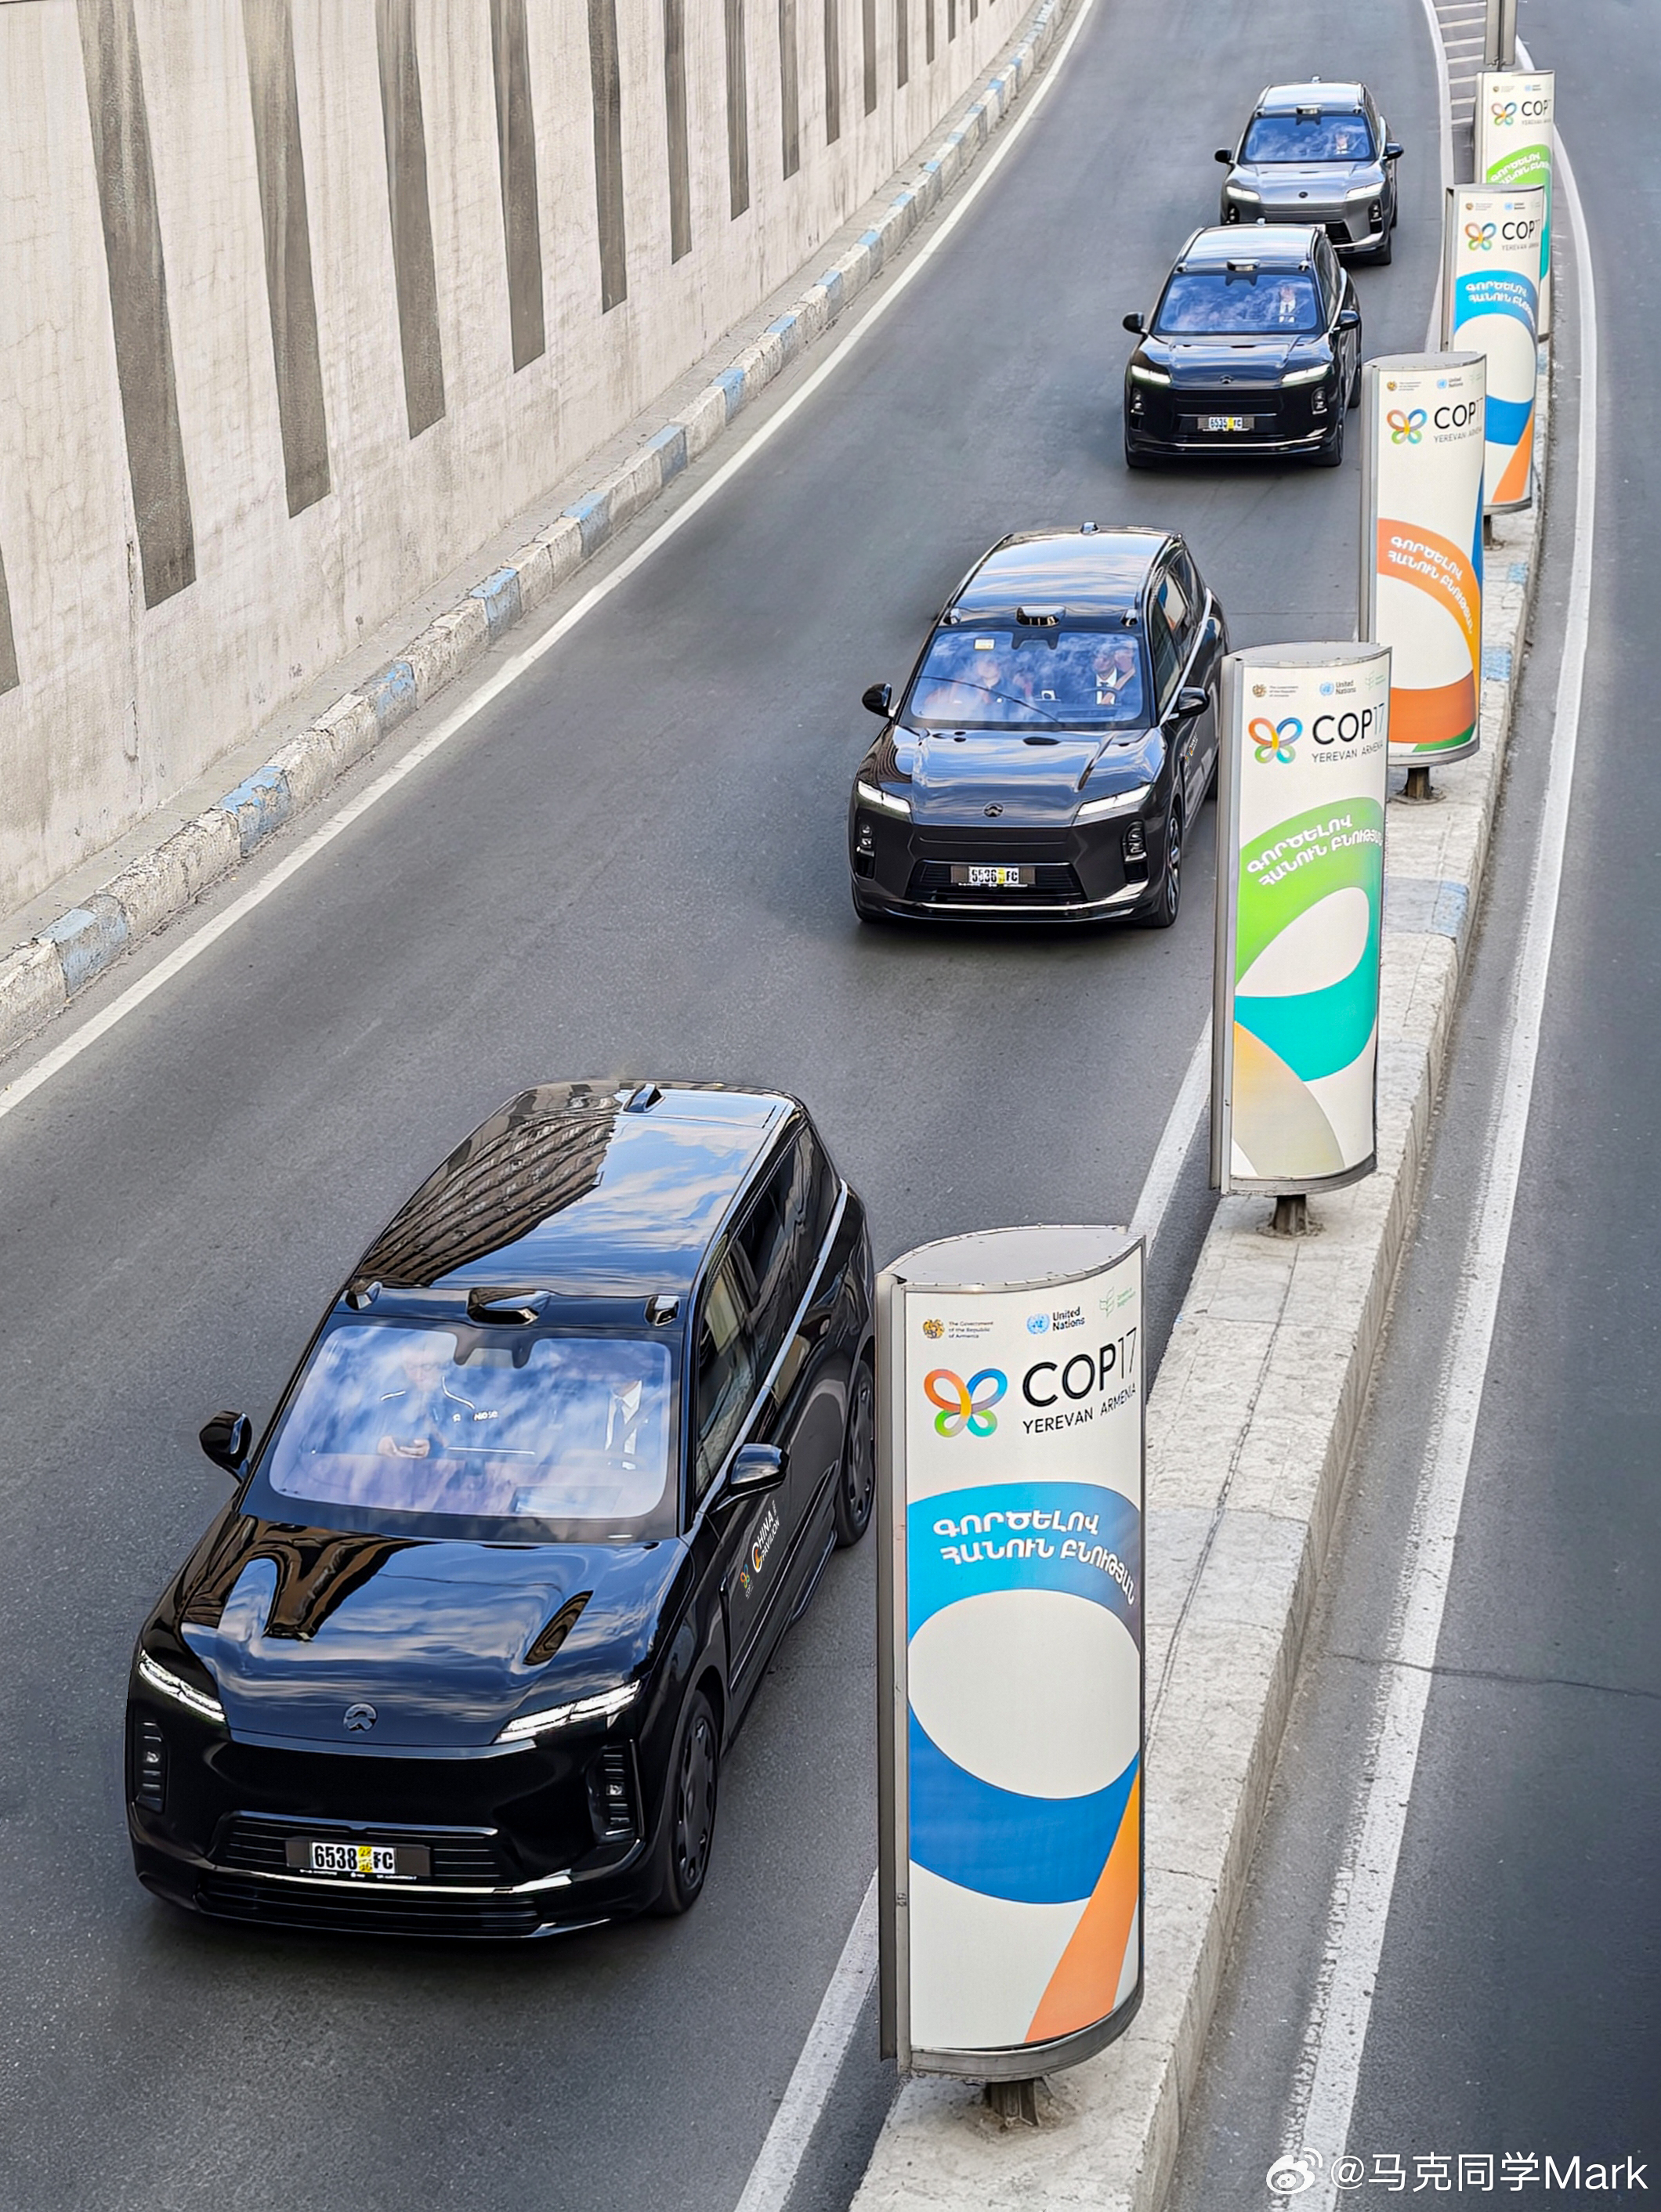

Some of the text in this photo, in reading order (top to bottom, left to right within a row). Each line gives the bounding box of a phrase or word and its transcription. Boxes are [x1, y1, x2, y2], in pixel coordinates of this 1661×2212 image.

[1522, 99, 1552, 116] COP
[1502, 219, 1540, 240] COP
[1434, 432, 1467, 443] YEREVAN
[1388, 550, 1439, 579] ՀԱՆՈՒՆ
[1391, 536, 1463, 581] ԳՈՐԾԵԼՈՎ
[1312, 703, 1384, 745] COP17
[1312, 749, 1358, 763] YEREVAN
[1247, 813, 1353, 873] ԳՈՐԾԵԼՈՎ
[1258, 844, 1328, 886] ՀԱՆՈՒՆ
[1052, 1307, 1080, 1321] United
[1052, 1316, 1085, 1332] Nations
[1022, 1327, 1137, 1408] COP17
[1022, 1382, 1136, 1434] YEREVAN ARMENIA
[933, 1509, 1099, 1538] ԳՈՐԾԵԼՈՎ
[939, 1538, 1135, 1606] ՀԱՆՈՒՆ ԲՆՈՒԹՅԱՆ
[314, 1845, 393, 1870] 6538 FC
